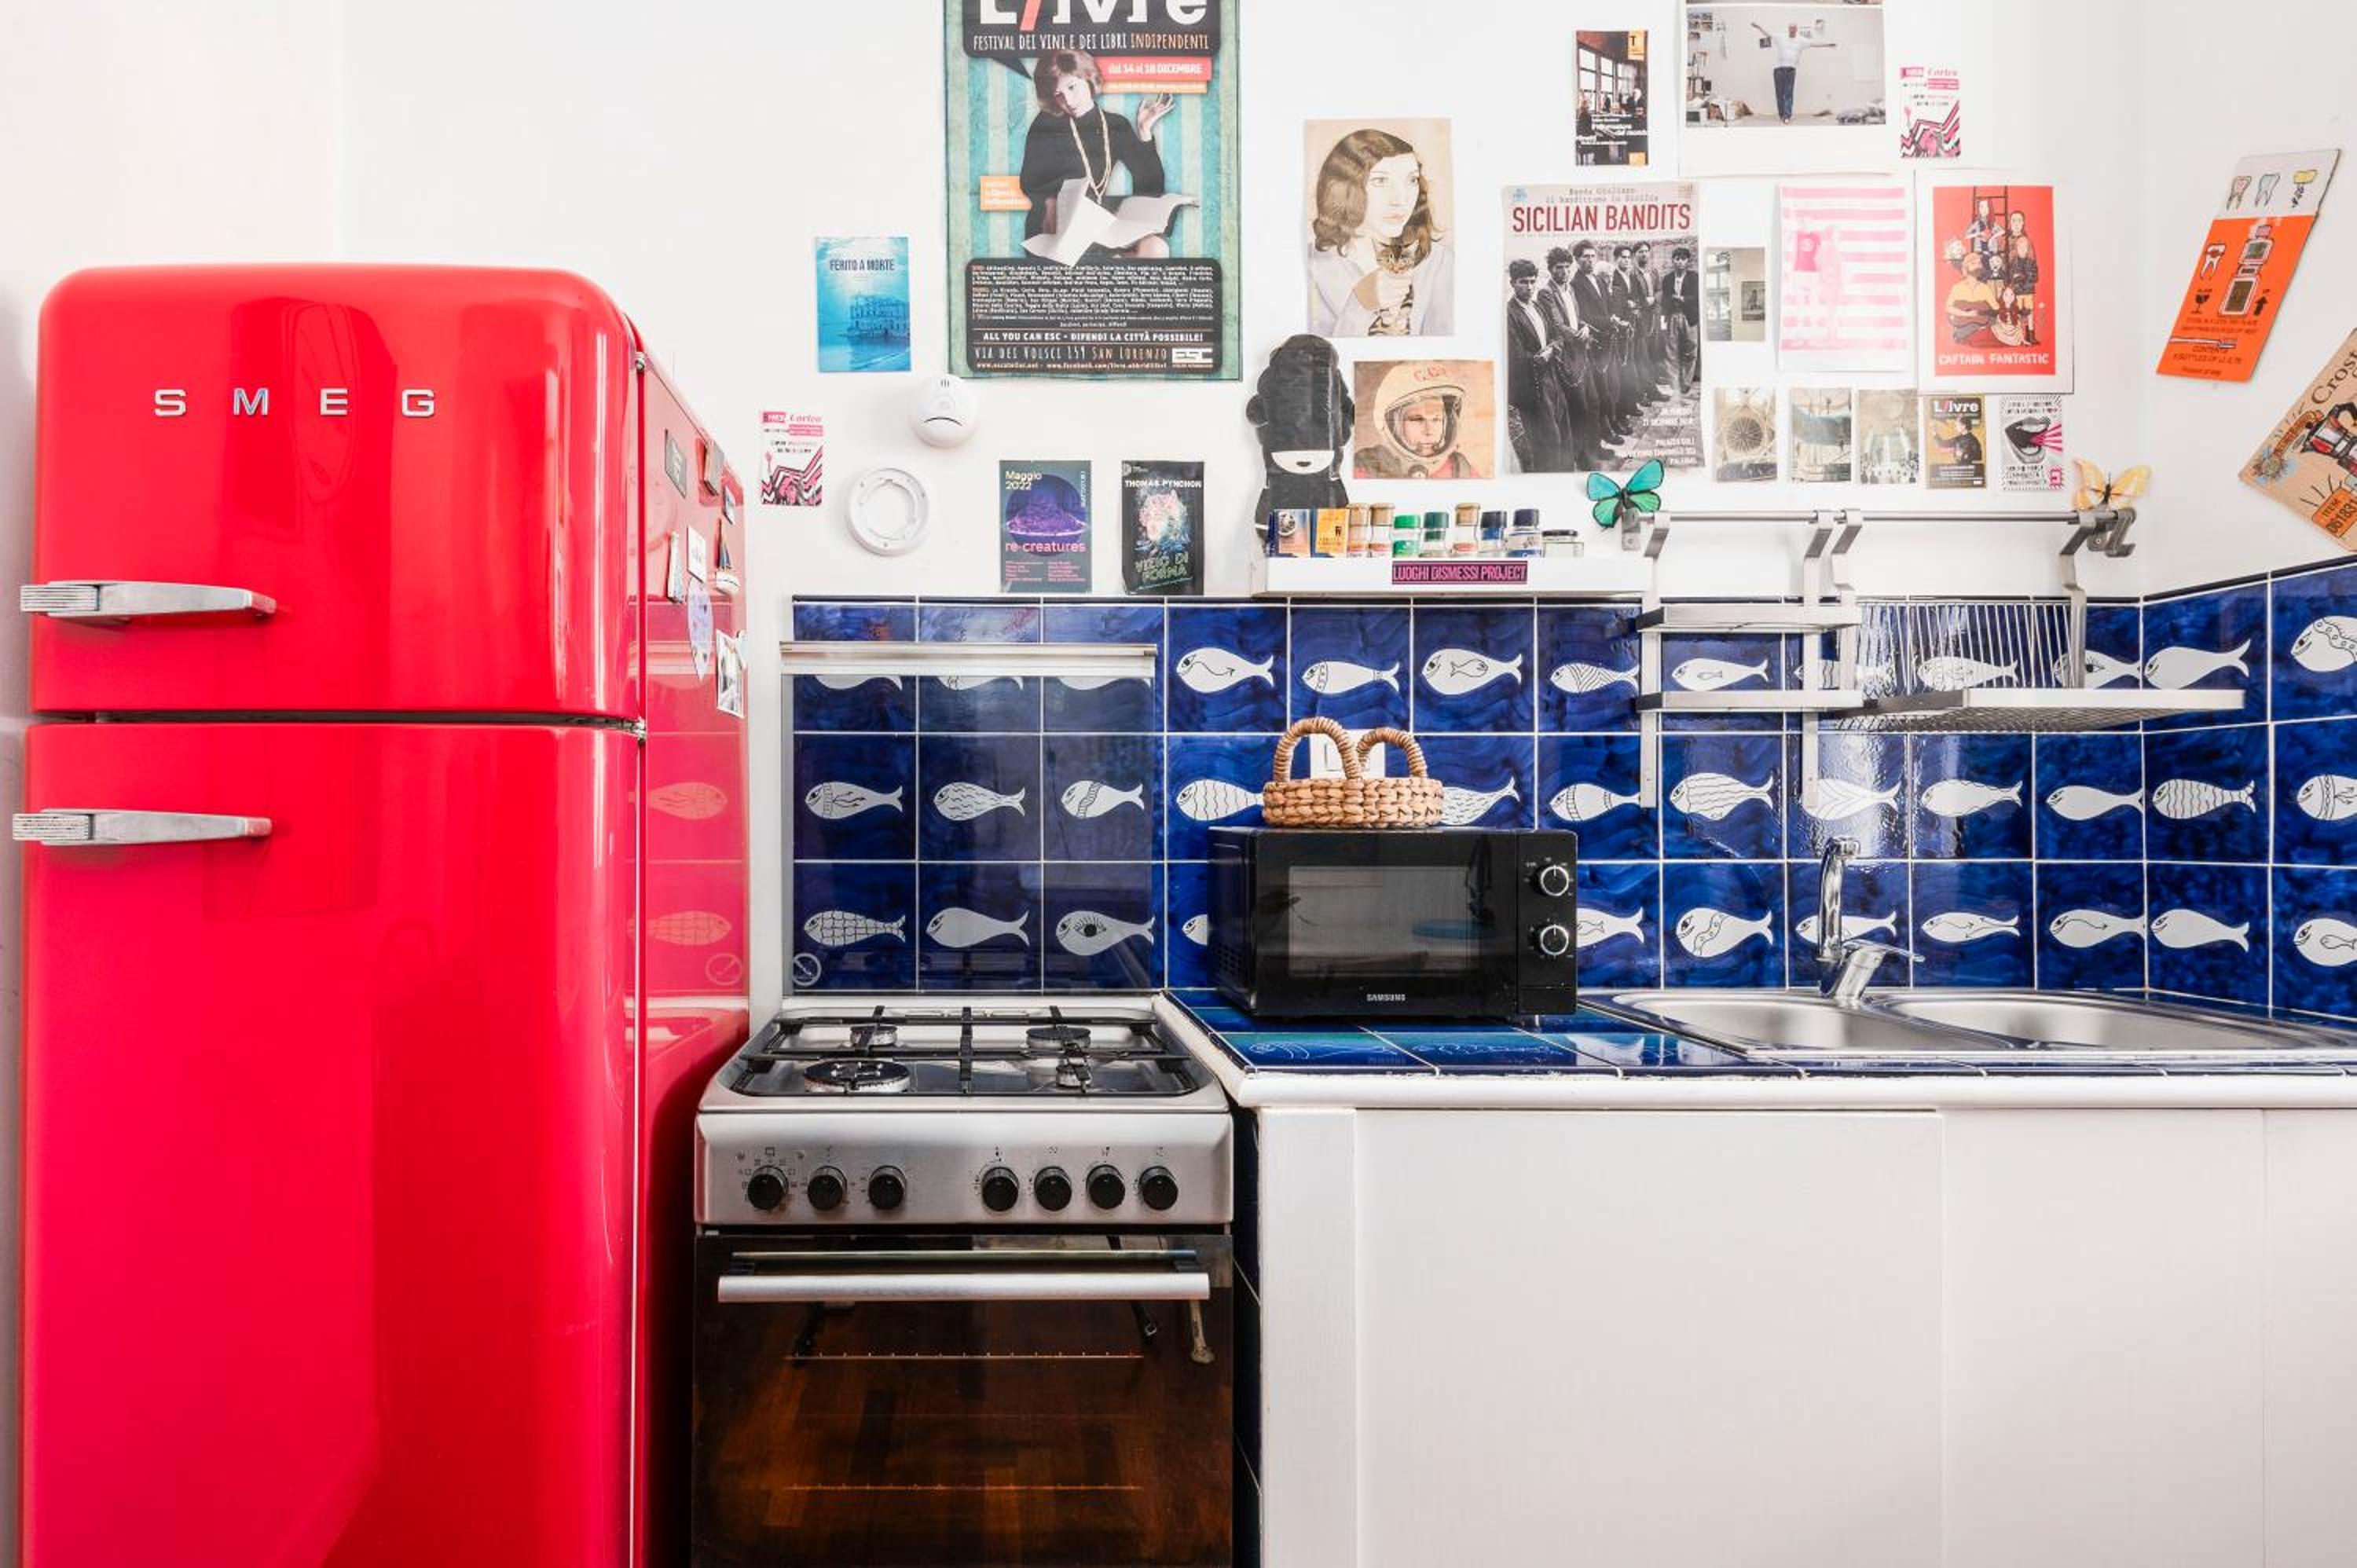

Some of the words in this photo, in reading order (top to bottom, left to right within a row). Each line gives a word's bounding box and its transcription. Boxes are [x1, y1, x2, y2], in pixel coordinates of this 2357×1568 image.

[973, 35, 1015, 50] FESTIVAL
[1019, 34, 1038, 49] DEI
[1039, 34, 1066, 49] VINI
[1069, 34, 1076, 49] E
[1079, 34, 1097, 49] DEI
[1101, 33, 1127, 49] LIBRI
[1131, 33, 1209, 49] INDIPENDENTI
[1512, 205, 1598, 233] SICILIAN
[1605, 203, 1692, 231] BANDITS
[829, 258, 858, 271] FERITO
[859, 259, 865, 271] A
[867, 258, 895, 271] MORTE
[983, 332, 1000, 341] ALL
[1003, 332, 1021, 341] YOU
[1023, 332, 1042, 341] CAN
[1044, 332, 1061, 341] ESC
[1071, 332, 1107, 342] DIFENDI
[1110, 333, 1121, 342] LA
[1124, 331, 1151, 342] CITTÀ
[1938, 354, 1985, 365] CAPTAIN
[1989, 353, 2050, 365] FANTASTIC
[155, 388, 435, 417] SMEG
[1005, 471, 1043, 482] Maggio
[1005, 482, 1032, 491] 2022
[1125, 479, 1161, 488] THOMAS
[1163, 479, 1202, 488] PYNCHON
[1005, 541, 1087, 552] re-creatures
[1393, 565, 1429, 581] LUOGHI
[1431, 565, 1479, 581] DISMESSI
[1481, 565, 1527, 581] PROJECT
